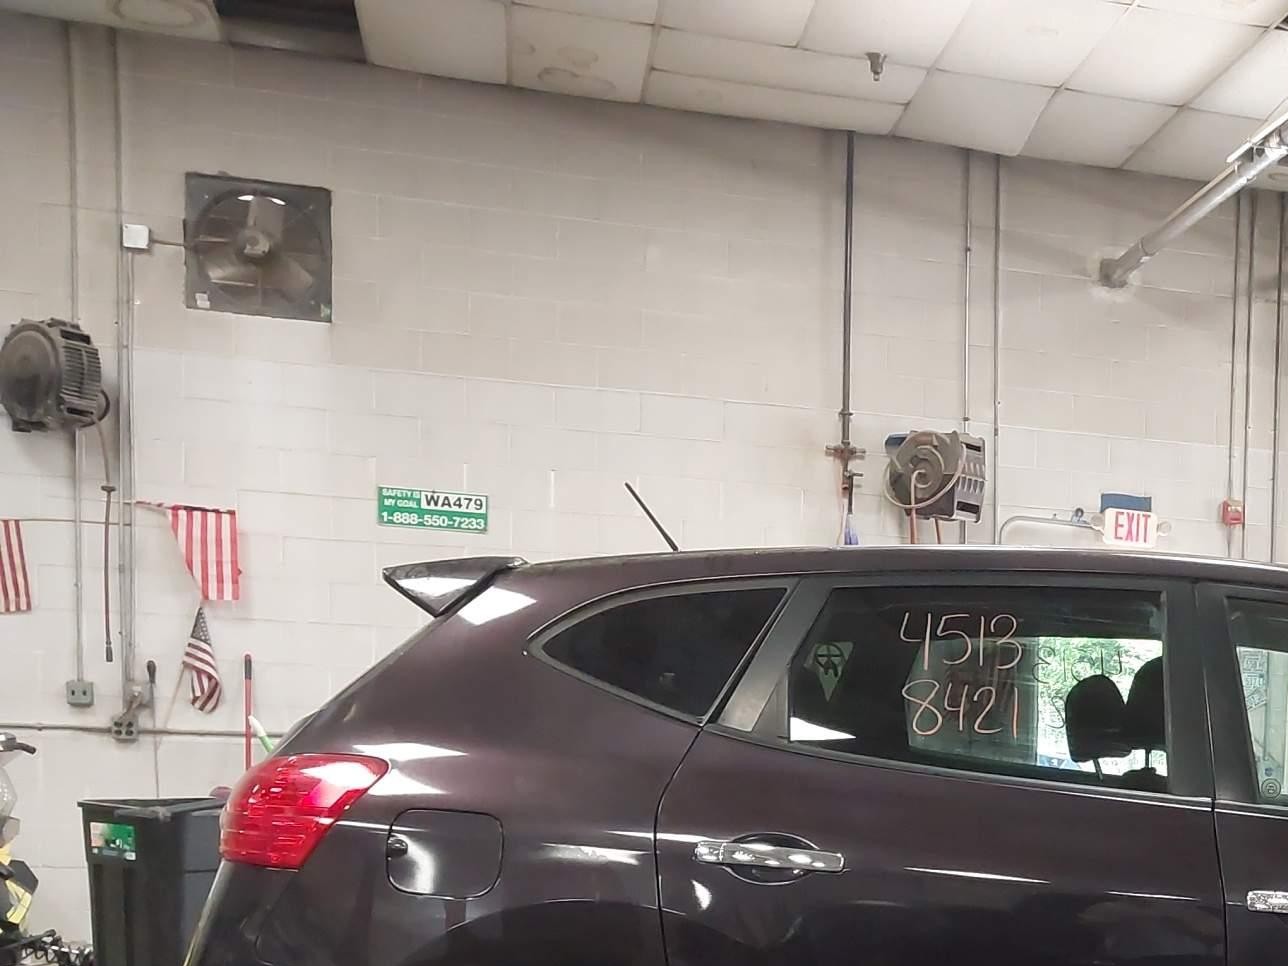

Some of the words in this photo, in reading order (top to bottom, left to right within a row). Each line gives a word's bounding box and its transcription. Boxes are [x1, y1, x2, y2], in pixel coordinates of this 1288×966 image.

[382, 488, 413, 498] SAFETY
[424, 494, 483, 511] WA479
[384, 498, 396, 507] MY
[397, 499, 419, 509] GOAL
[381, 511, 485, 530] 1-888-550-7233
[1114, 511, 1151, 543] EXIT
[900, 612, 1023, 671] 4513
[902, 679, 1018, 739] 8421
